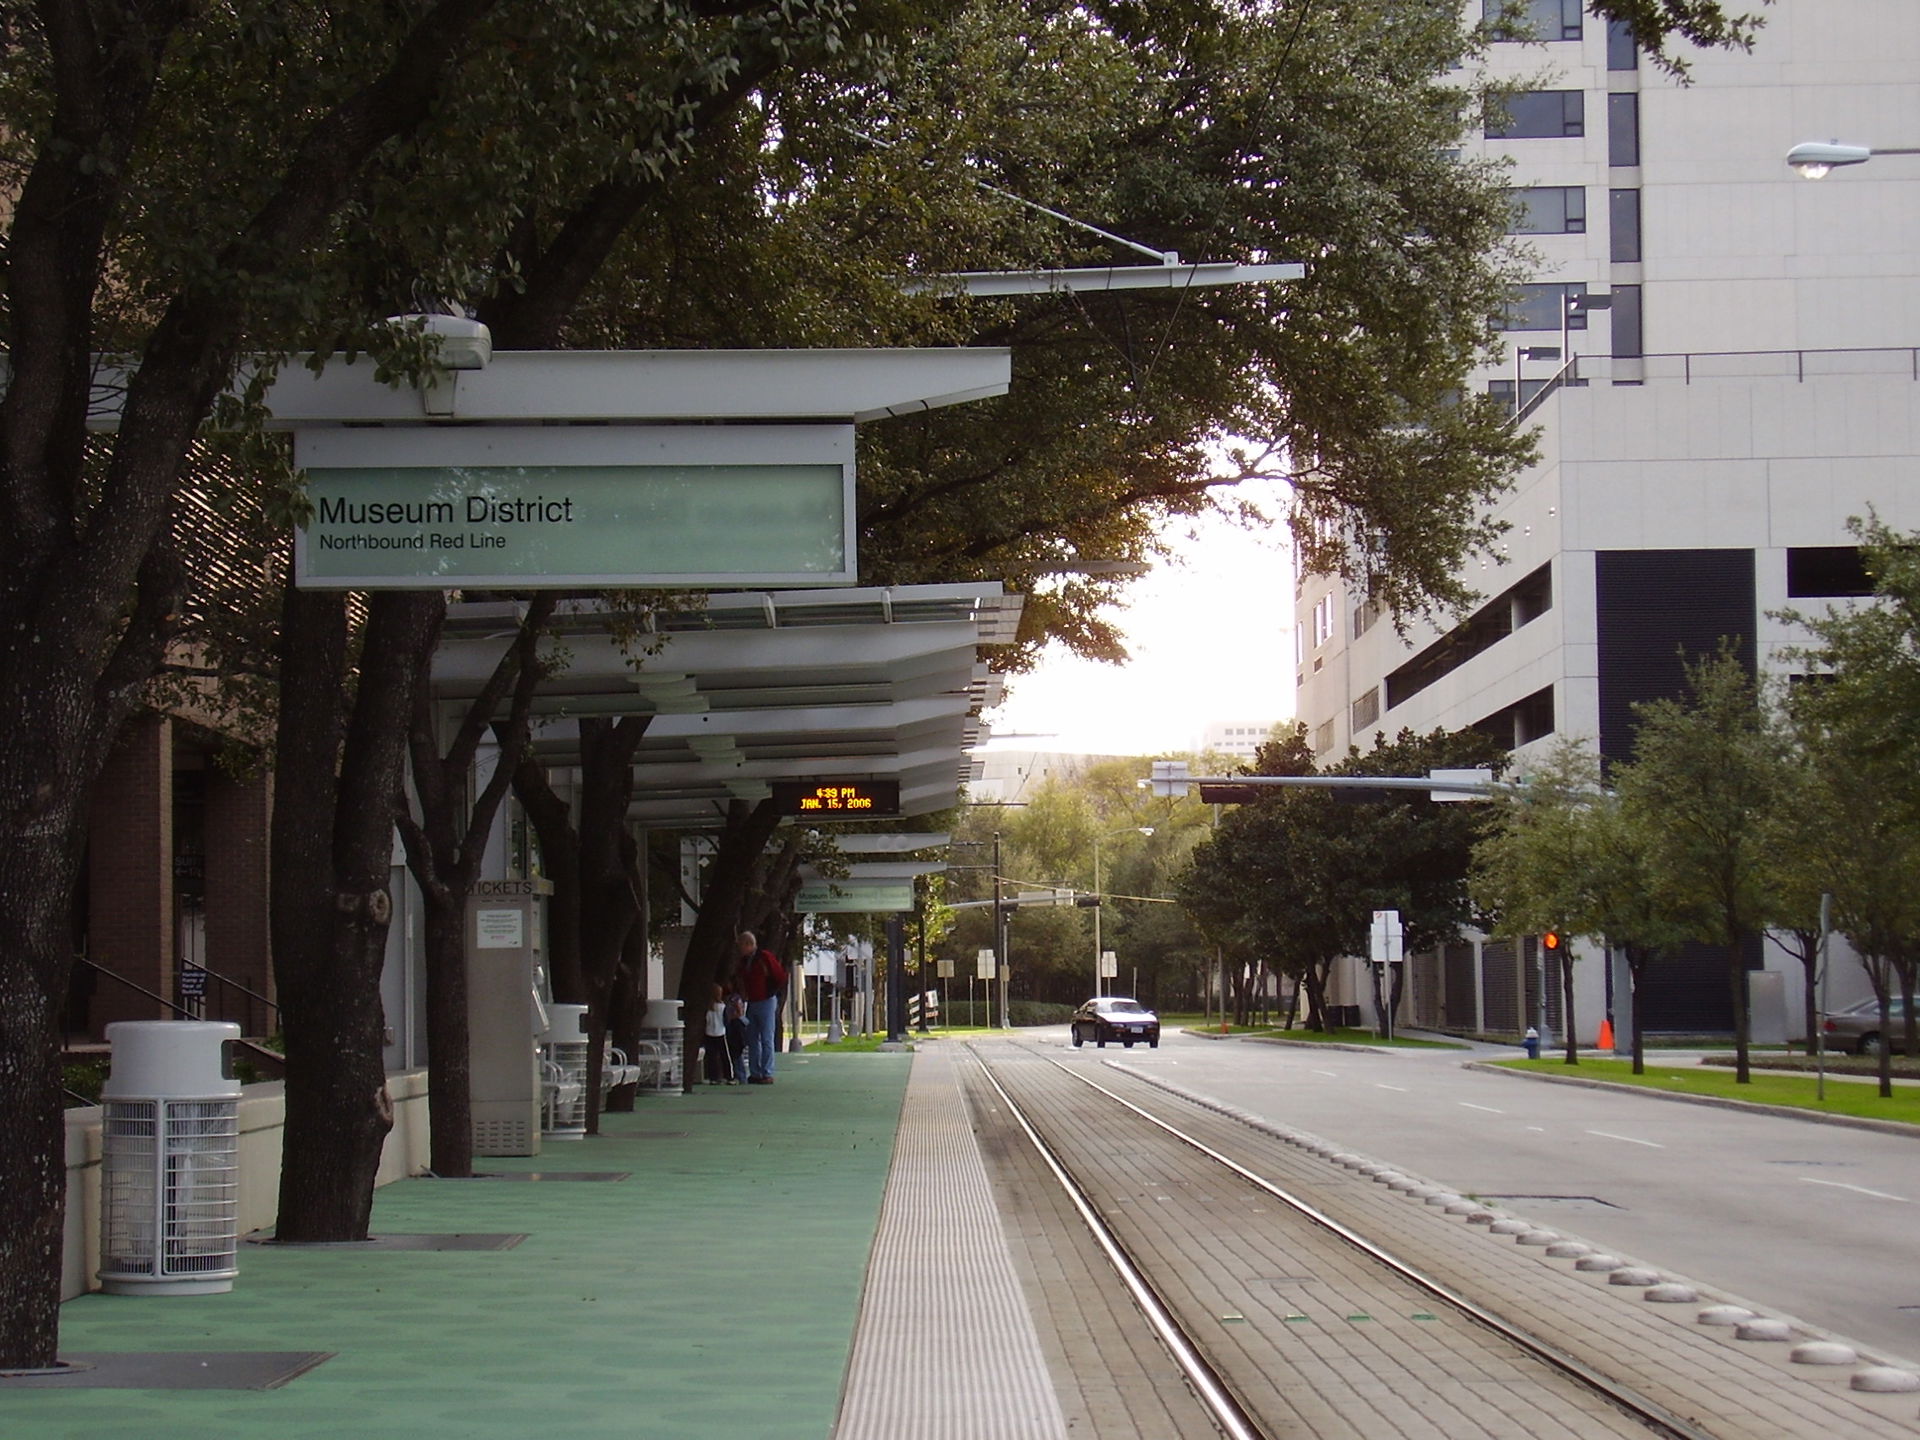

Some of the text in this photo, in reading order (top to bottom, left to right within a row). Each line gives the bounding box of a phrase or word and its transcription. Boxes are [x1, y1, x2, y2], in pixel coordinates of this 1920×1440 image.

[319, 495, 573, 524] Museum District
[320, 533, 506, 550] Northbound Red Line
[841, 787, 855, 798] PM
[800, 798, 871, 809] JAN. 15, 2006
